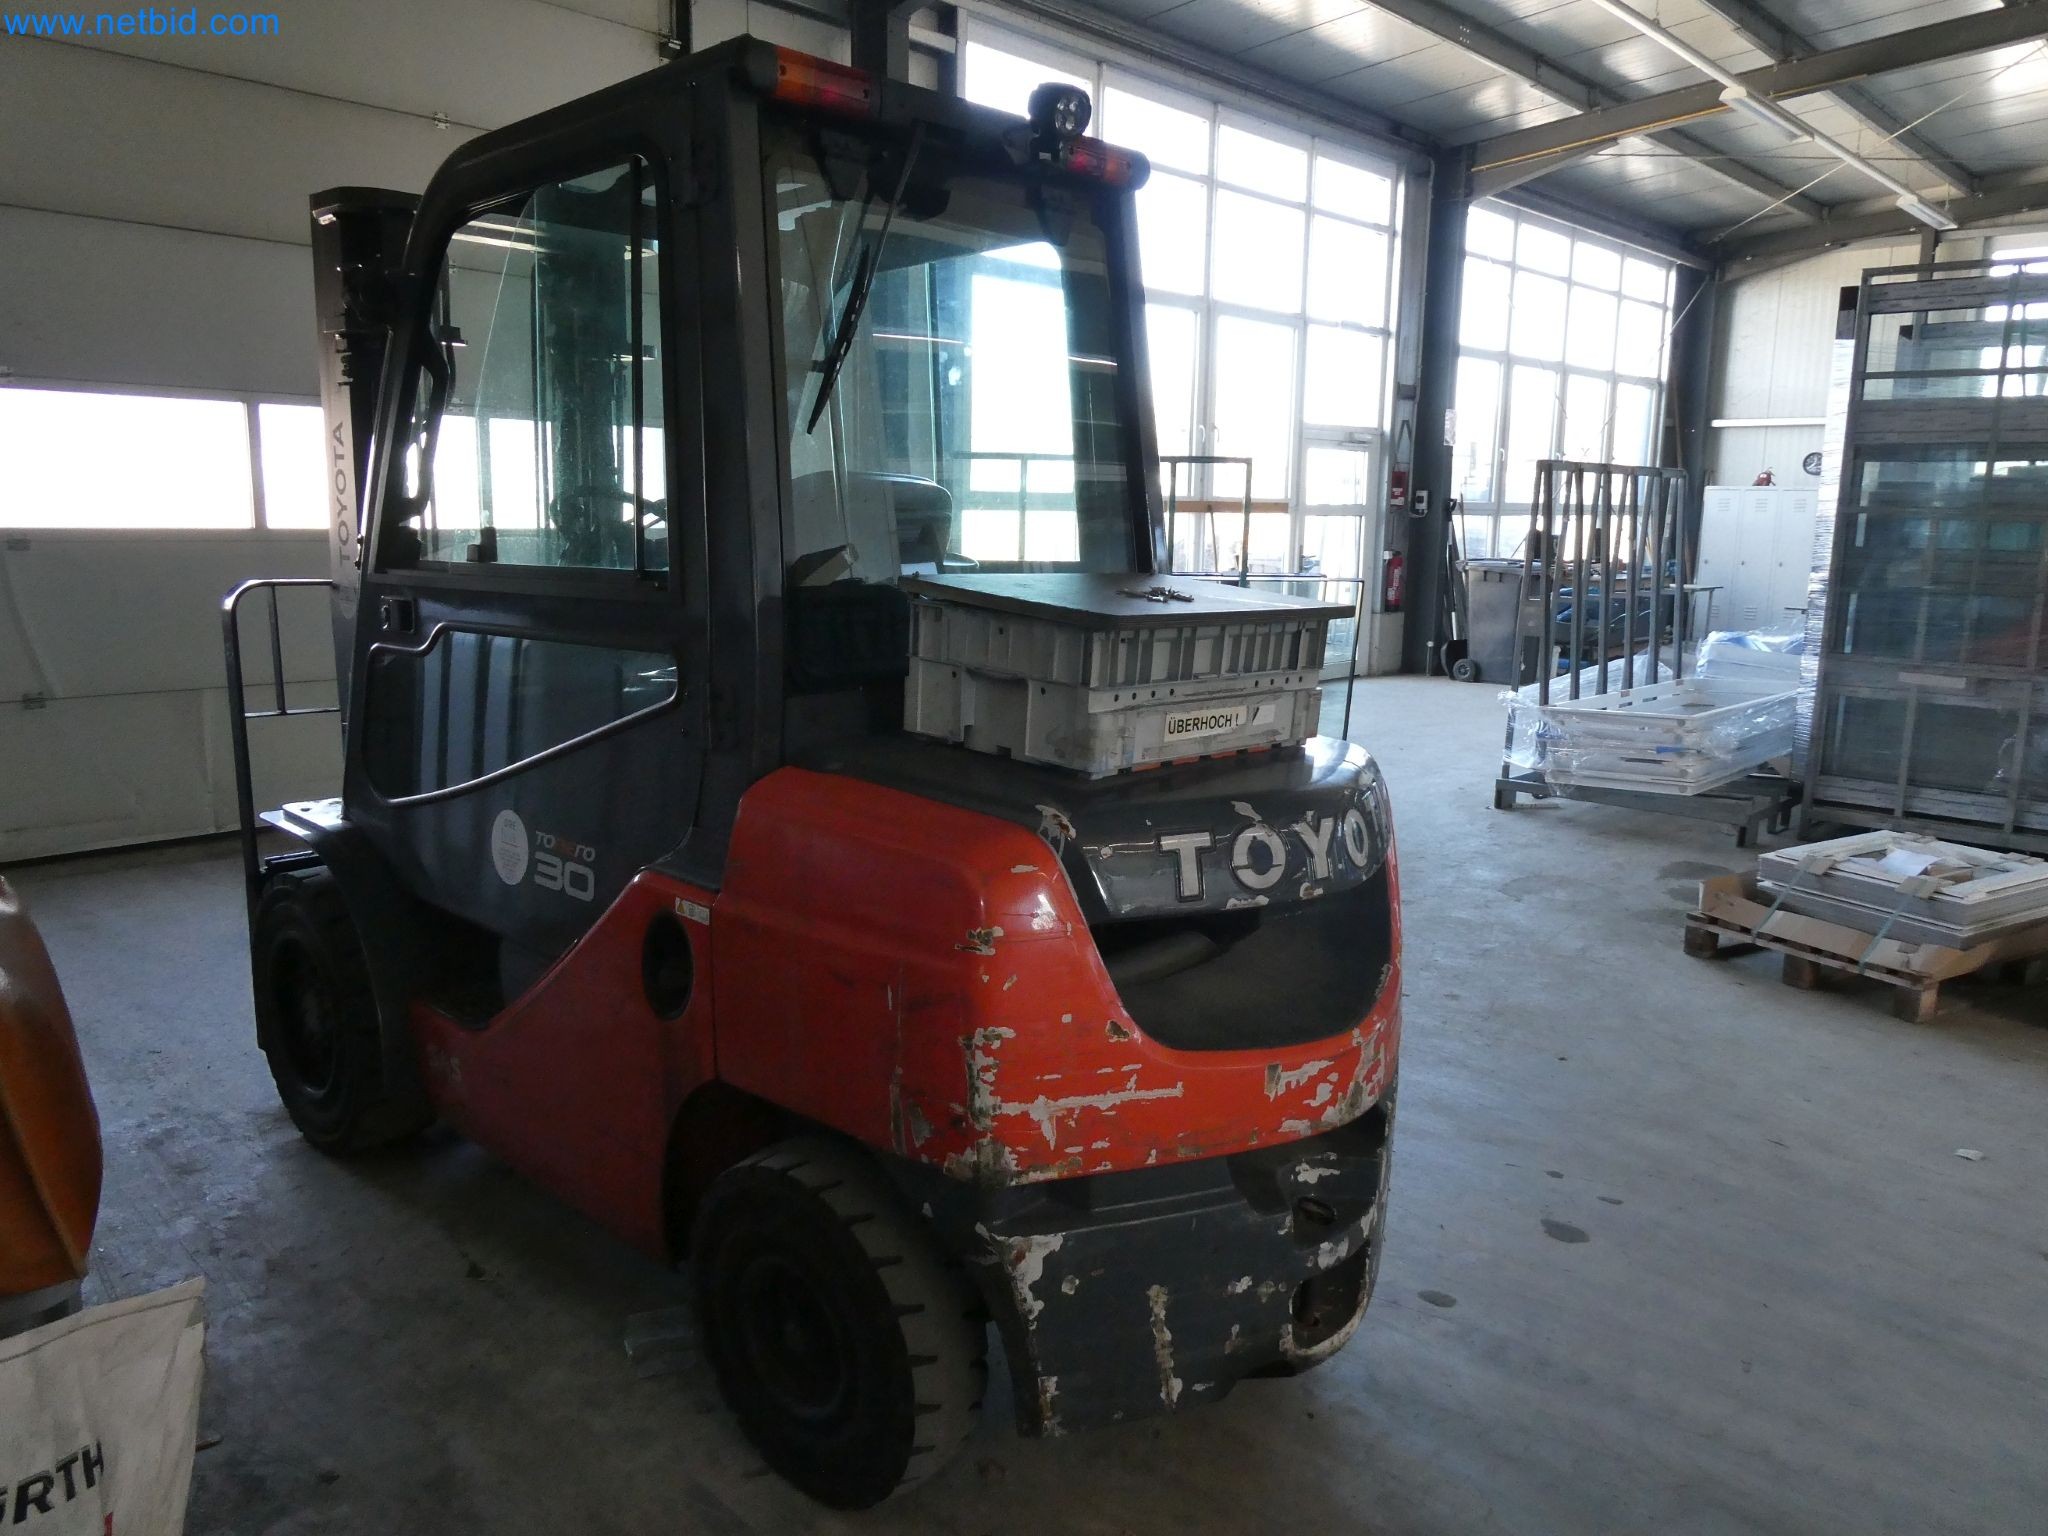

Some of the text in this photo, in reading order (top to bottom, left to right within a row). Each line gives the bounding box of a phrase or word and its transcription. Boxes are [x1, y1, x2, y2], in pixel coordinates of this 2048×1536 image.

[332, 421, 351, 568] TOYOTA
[1168, 714, 1233, 735] ÜBERHOCH
[534, 851, 595, 902] 30
[0, 1440, 104, 1525] RTH
